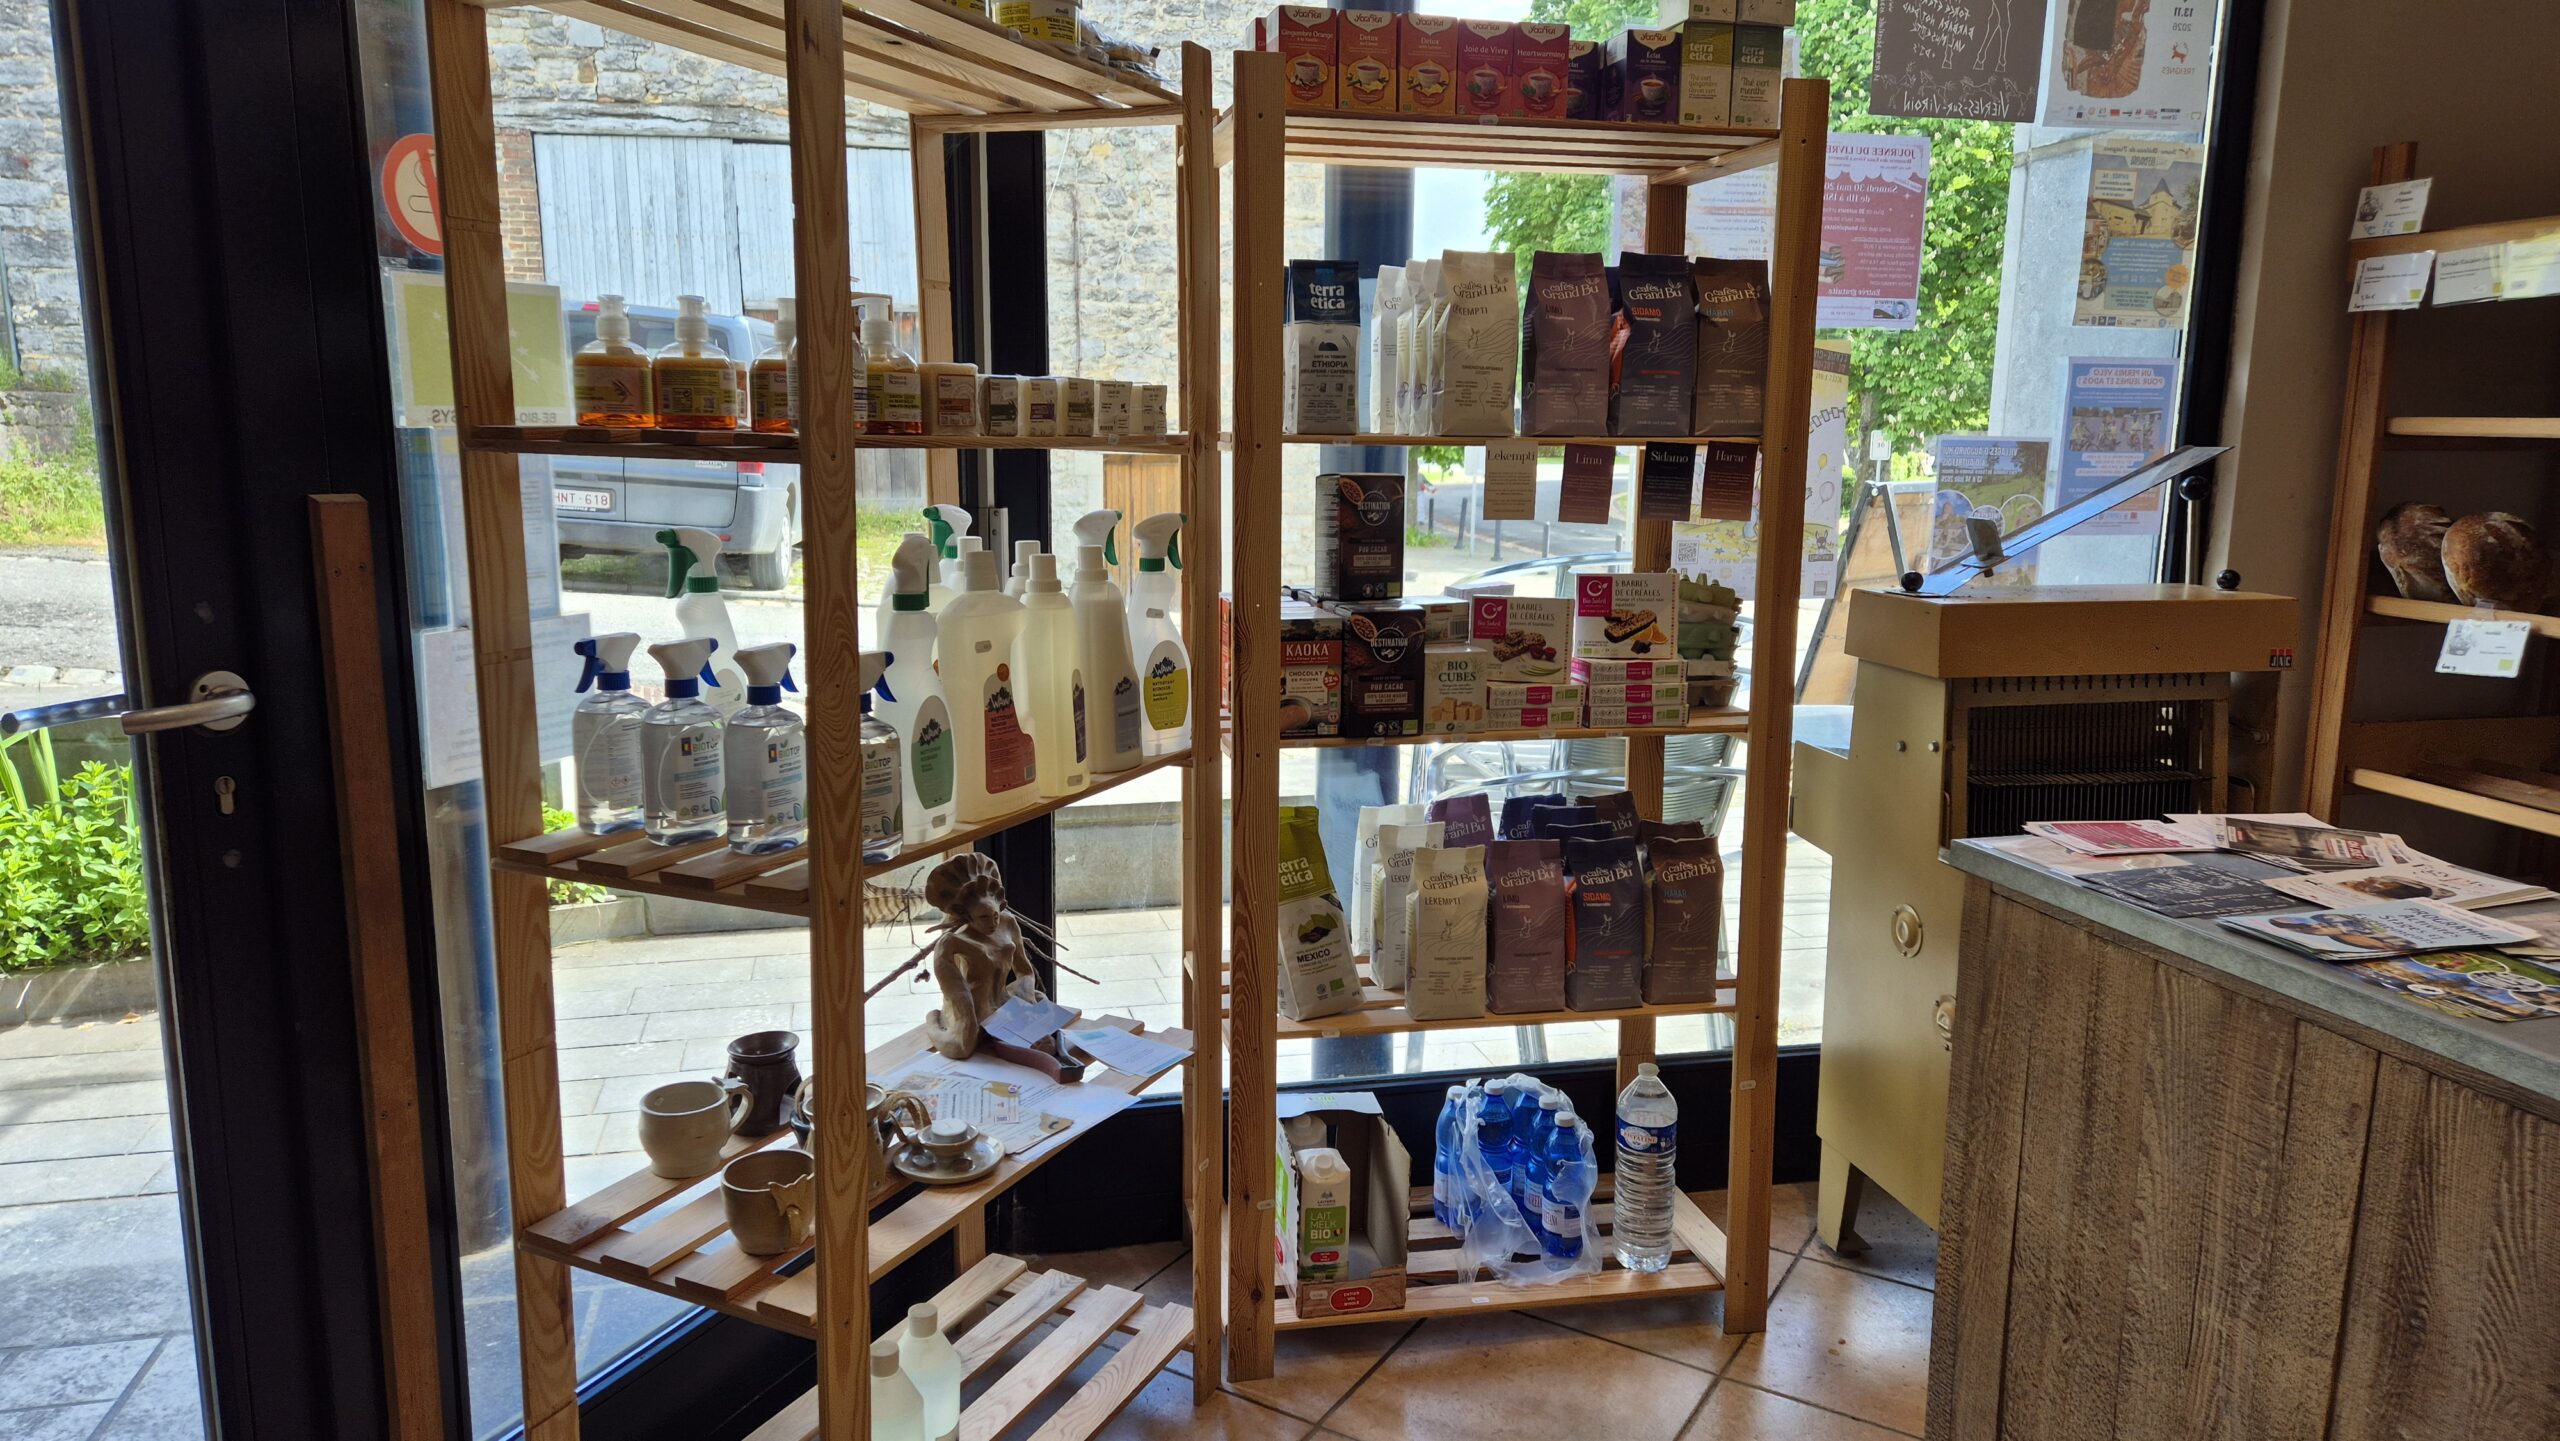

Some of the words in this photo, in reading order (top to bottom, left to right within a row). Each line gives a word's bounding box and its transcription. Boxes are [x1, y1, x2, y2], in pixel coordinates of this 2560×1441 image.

[1312, 30, 1334, 39] Orange
[1463, 45, 1479, 54] Joie
[1490, 46, 1509, 55] Vivre
[1690, 43, 1713, 52] terra
[1742, 45, 1765, 54] terra
[1517, 49, 1566, 60] Heartwarming
[1756, 79, 1770, 88] vert
[1740, 87, 1767, 96] menthe
[1309, 282, 1345, 297] terra
[1453, 284, 1488, 299] Grand
[1543, 287, 1580, 299] Grand
[1628, 288, 1664, 300] Grand
[1705, 291, 1743, 303] Grand
[1631, 307, 1661, 317] SIDAMO
[1487, 450, 1535, 465] Lekempti
[1575, 453, 1602, 465] Limu
[1651, 450, 1689, 463] Sidamo
[1716, 450, 1747, 463] Harar
[1358, 501, 1391, 510] DESTINATION
[1621, 580, 1649, 588] BARRES
[1615, 589, 1626, 597] DE
[1627, 588, 1661, 597] CÉRÉALES
[1515, 602, 1543, 611] BARRES
[1520, 611, 1555, 621] CÉRÉALES
[1370, 638, 1408, 647] DESTINATION
[1286, 643, 1329, 657] KAOKA
[1447, 661, 1468, 671] BIO
[2271, 656, 2290, 666] JAC
[1438, 672, 1476, 682] CUBES
[1370, 683, 1383, 691] PUR
[1384, 682, 1403, 691] CACAO
[778, 746, 801, 759] BIOTOP
[865, 757, 891, 769] BIOTOP
[1500, 873, 1536, 888] Grand
[1580, 873, 1616, 886] Grand
[1662, 868, 1699, 883] Grand
[1423, 876, 1458, 890] Grand
[1424, 897, 1461, 906] LEKEMPTI
[1583, 892, 1611, 902] SIDAMO
[2403, 906, 2500, 940] PROGRAMME
[1296, 948, 1331, 964] MEXICO
[1310, 1210, 1331, 1221] LAIT
[1310, 1220, 1337, 1230] MELK
[1310, 1229, 1332, 1240] BIO
